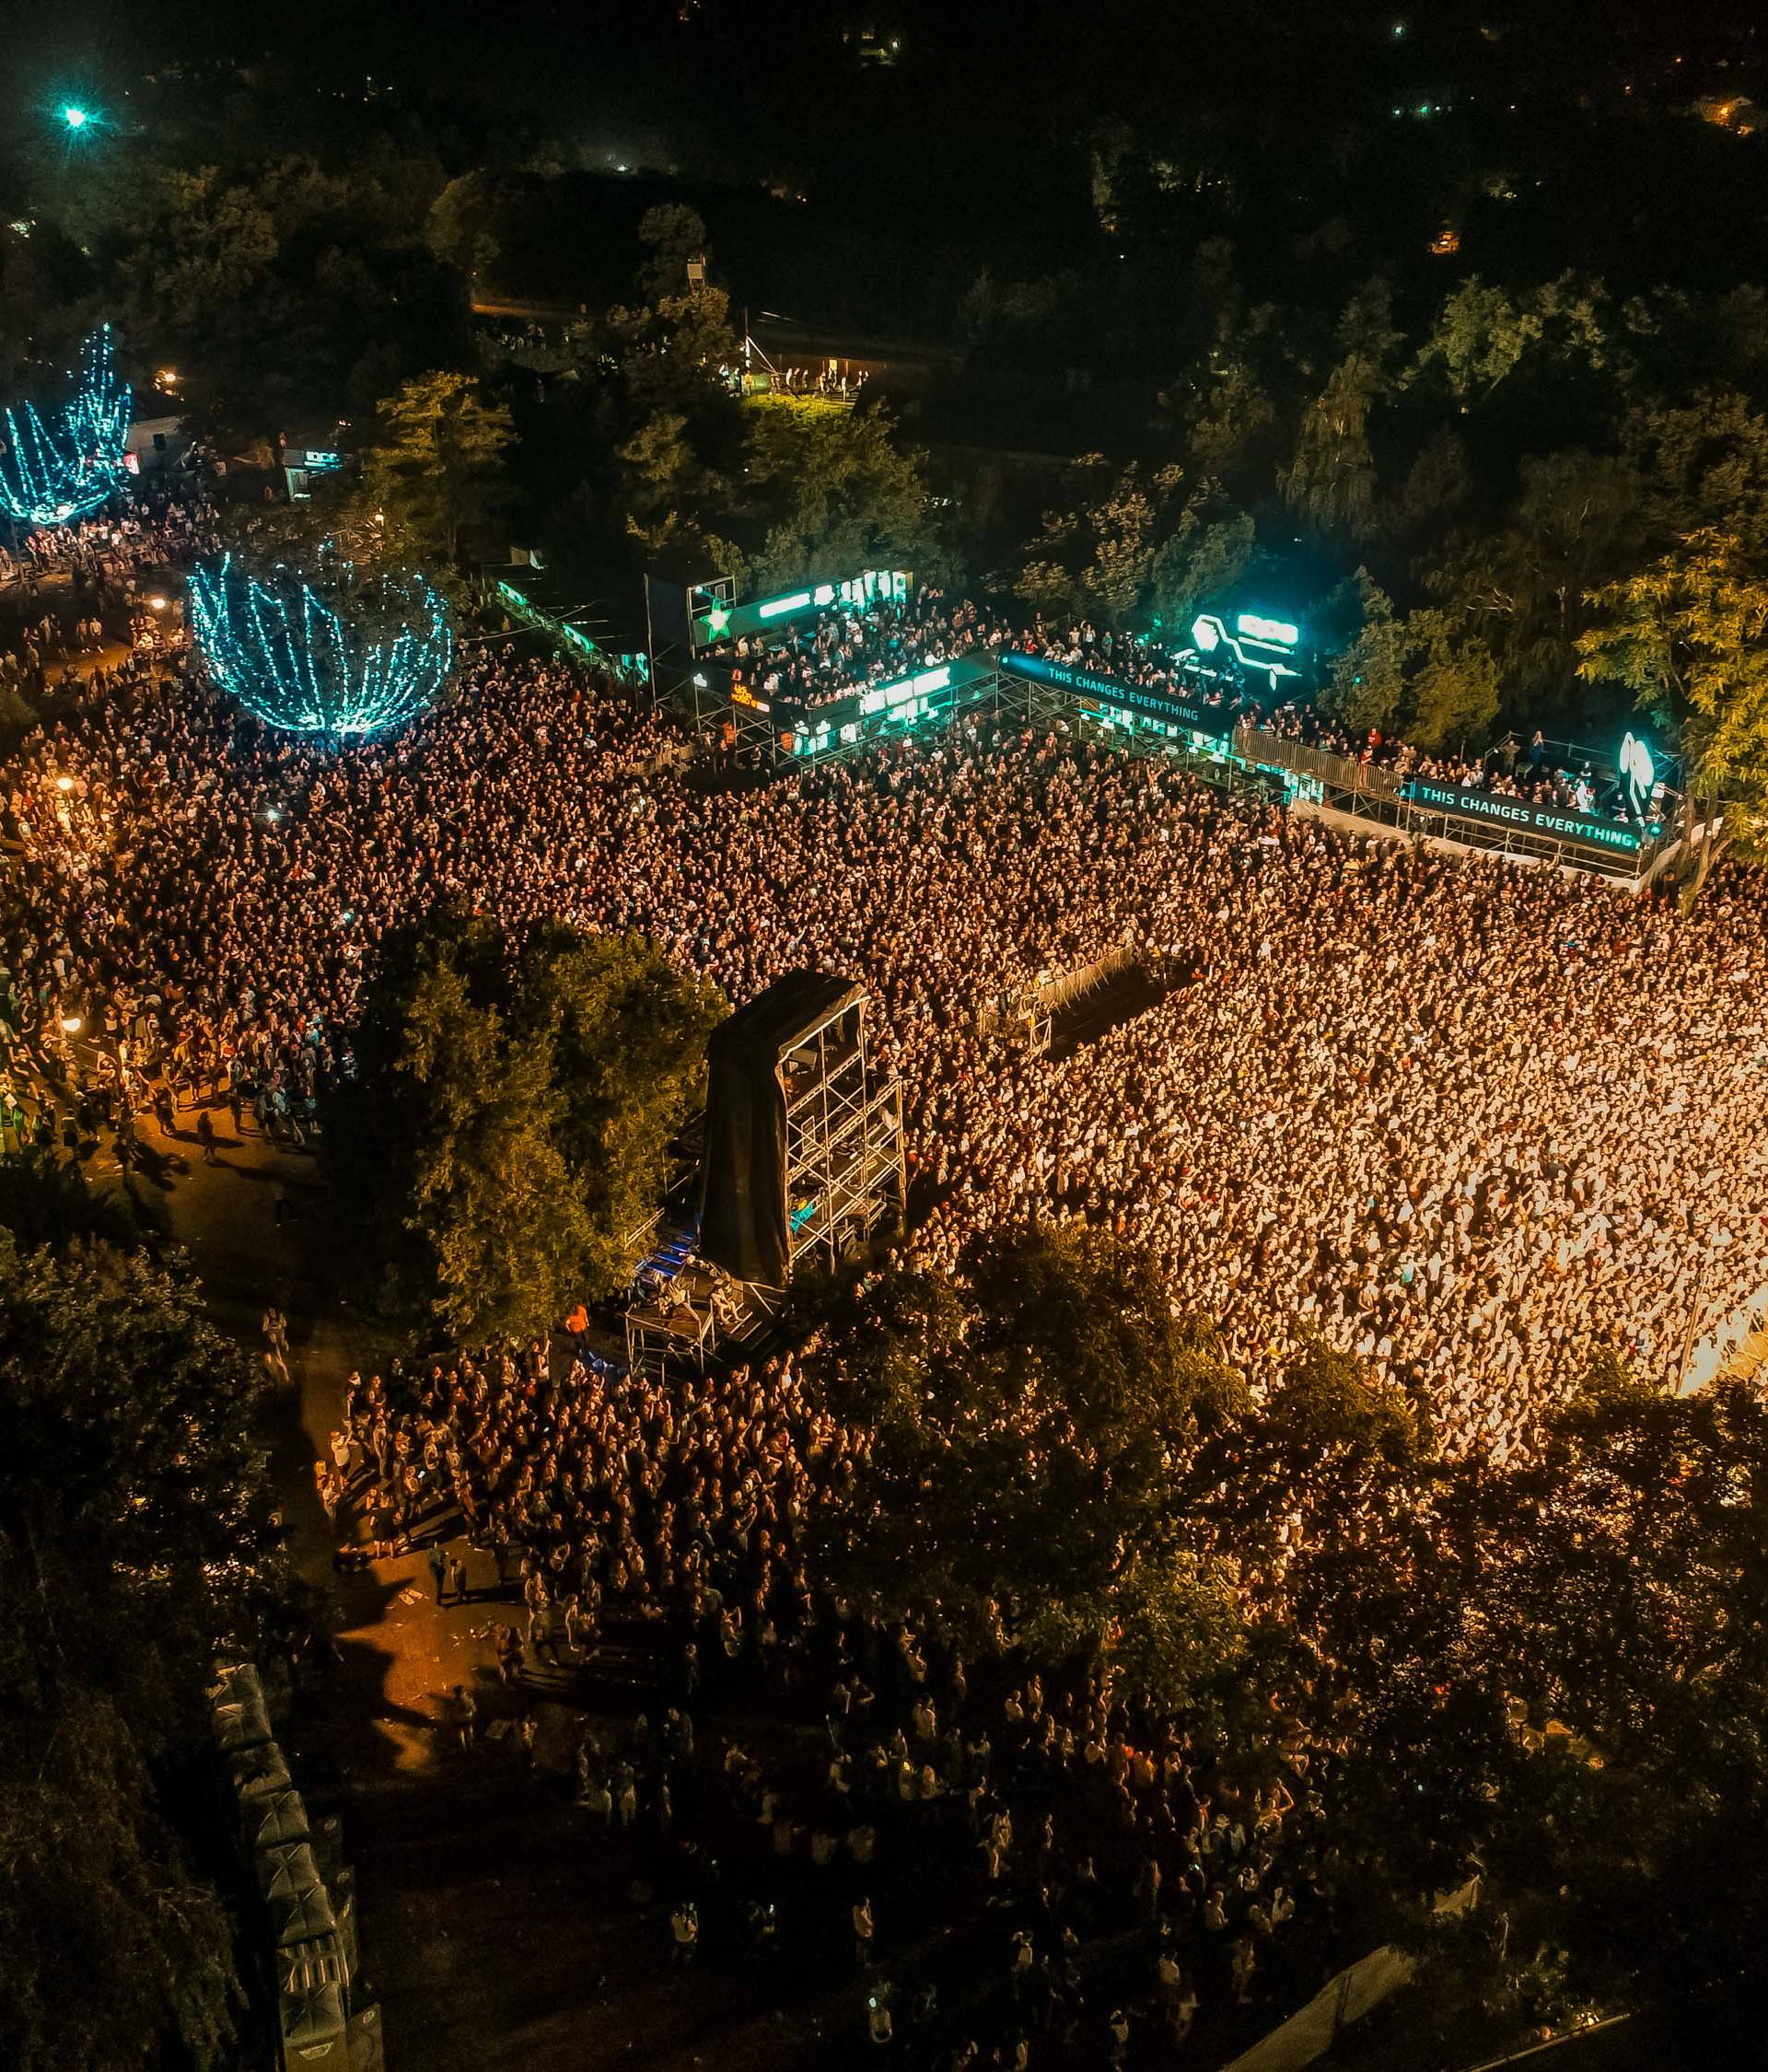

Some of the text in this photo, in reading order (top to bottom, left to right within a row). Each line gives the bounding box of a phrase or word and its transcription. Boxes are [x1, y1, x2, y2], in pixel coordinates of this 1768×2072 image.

[1048, 668, 1199, 721] THIS CHANGES EVERYTHING
[1422, 787, 1634, 847] THIS CHANGES EVERYTHING
